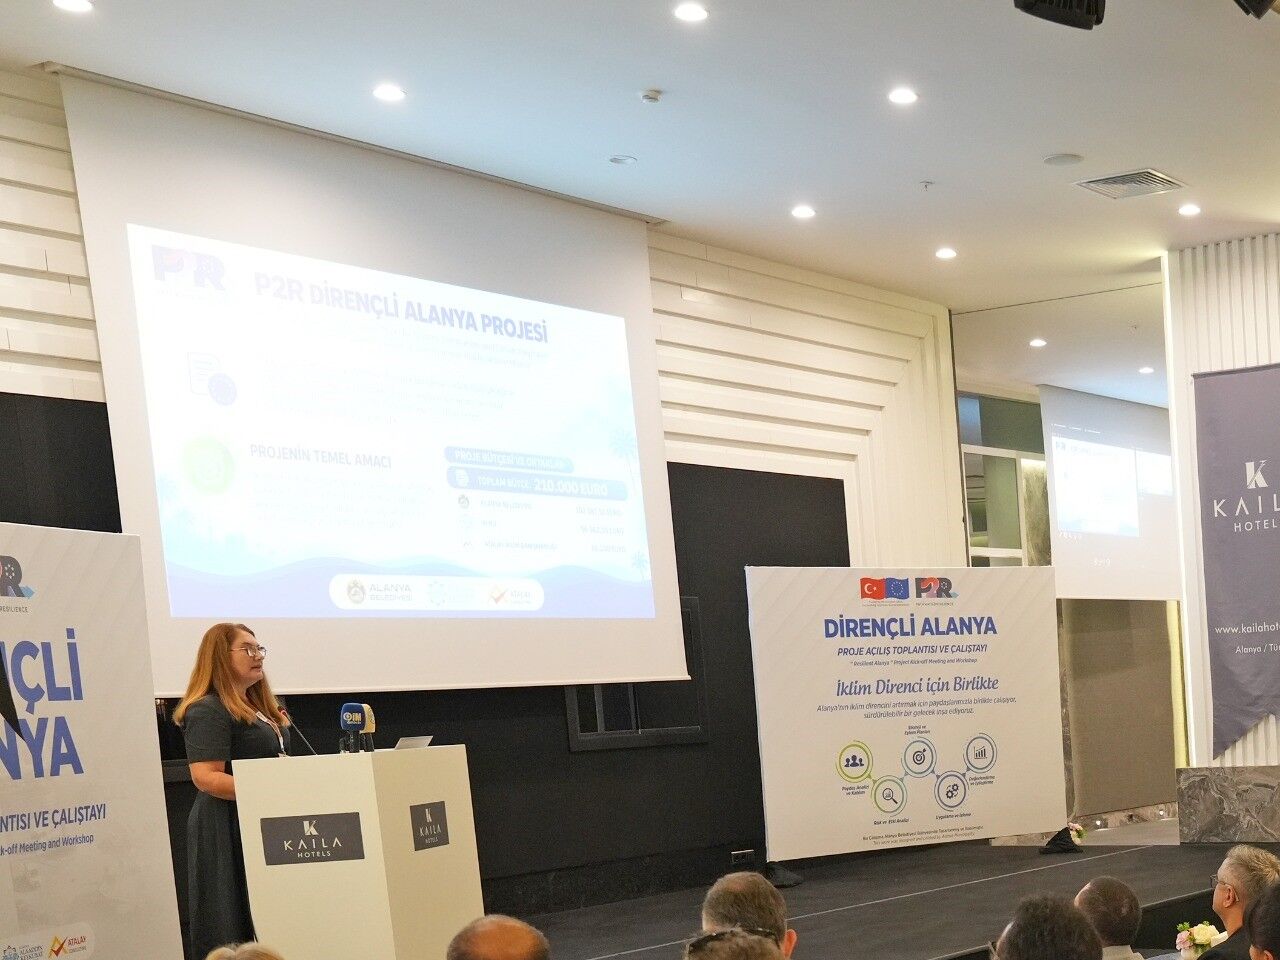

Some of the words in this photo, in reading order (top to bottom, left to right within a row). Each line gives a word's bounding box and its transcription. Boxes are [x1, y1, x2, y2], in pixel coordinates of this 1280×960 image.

[253, 271, 304, 304] P2R
[309, 280, 399, 319] DİRENÇLİ
[404, 300, 478, 332] ALANYA
[481, 314, 549, 343] PROJESİ
[313, 450, 352, 465] TEMEL
[354, 454, 392, 469] AMACI
[914, 576, 953, 599] P2R
[823, 613, 916, 640] DİRENÇLİ
[920, 616, 998, 636] ALANYA
[837, 647, 864, 657] PROJE
[865, 646, 891, 657] AÇILIŞ
[892, 645, 938, 655] TOPLANTISI
[939, 645, 949, 654] VE
[950, 643, 988, 654] ÇALIŞTAYI
[1235, 643, 1262, 655] Alanya
[0, 627, 84, 715] ÇLİ
[836, 679, 871, 697] İklim
[875, 677, 923, 695] Direnci
[926, 678, 950, 696] için
[953, 675, 1000, 692] Birlikte
[33, 810, 49, 829] VE
[51, 803, 106, 829] ÇALIŞTAYI
[420, 823, 442, 837] KAILA
[19, 840, 47, 853] Meeting
[48, 838, 60, 849] and
[61, 833, 95, 847] Workshop
[283, 837, 342, 851] KAILA
[297, 850, 332, 858] HOTELS
